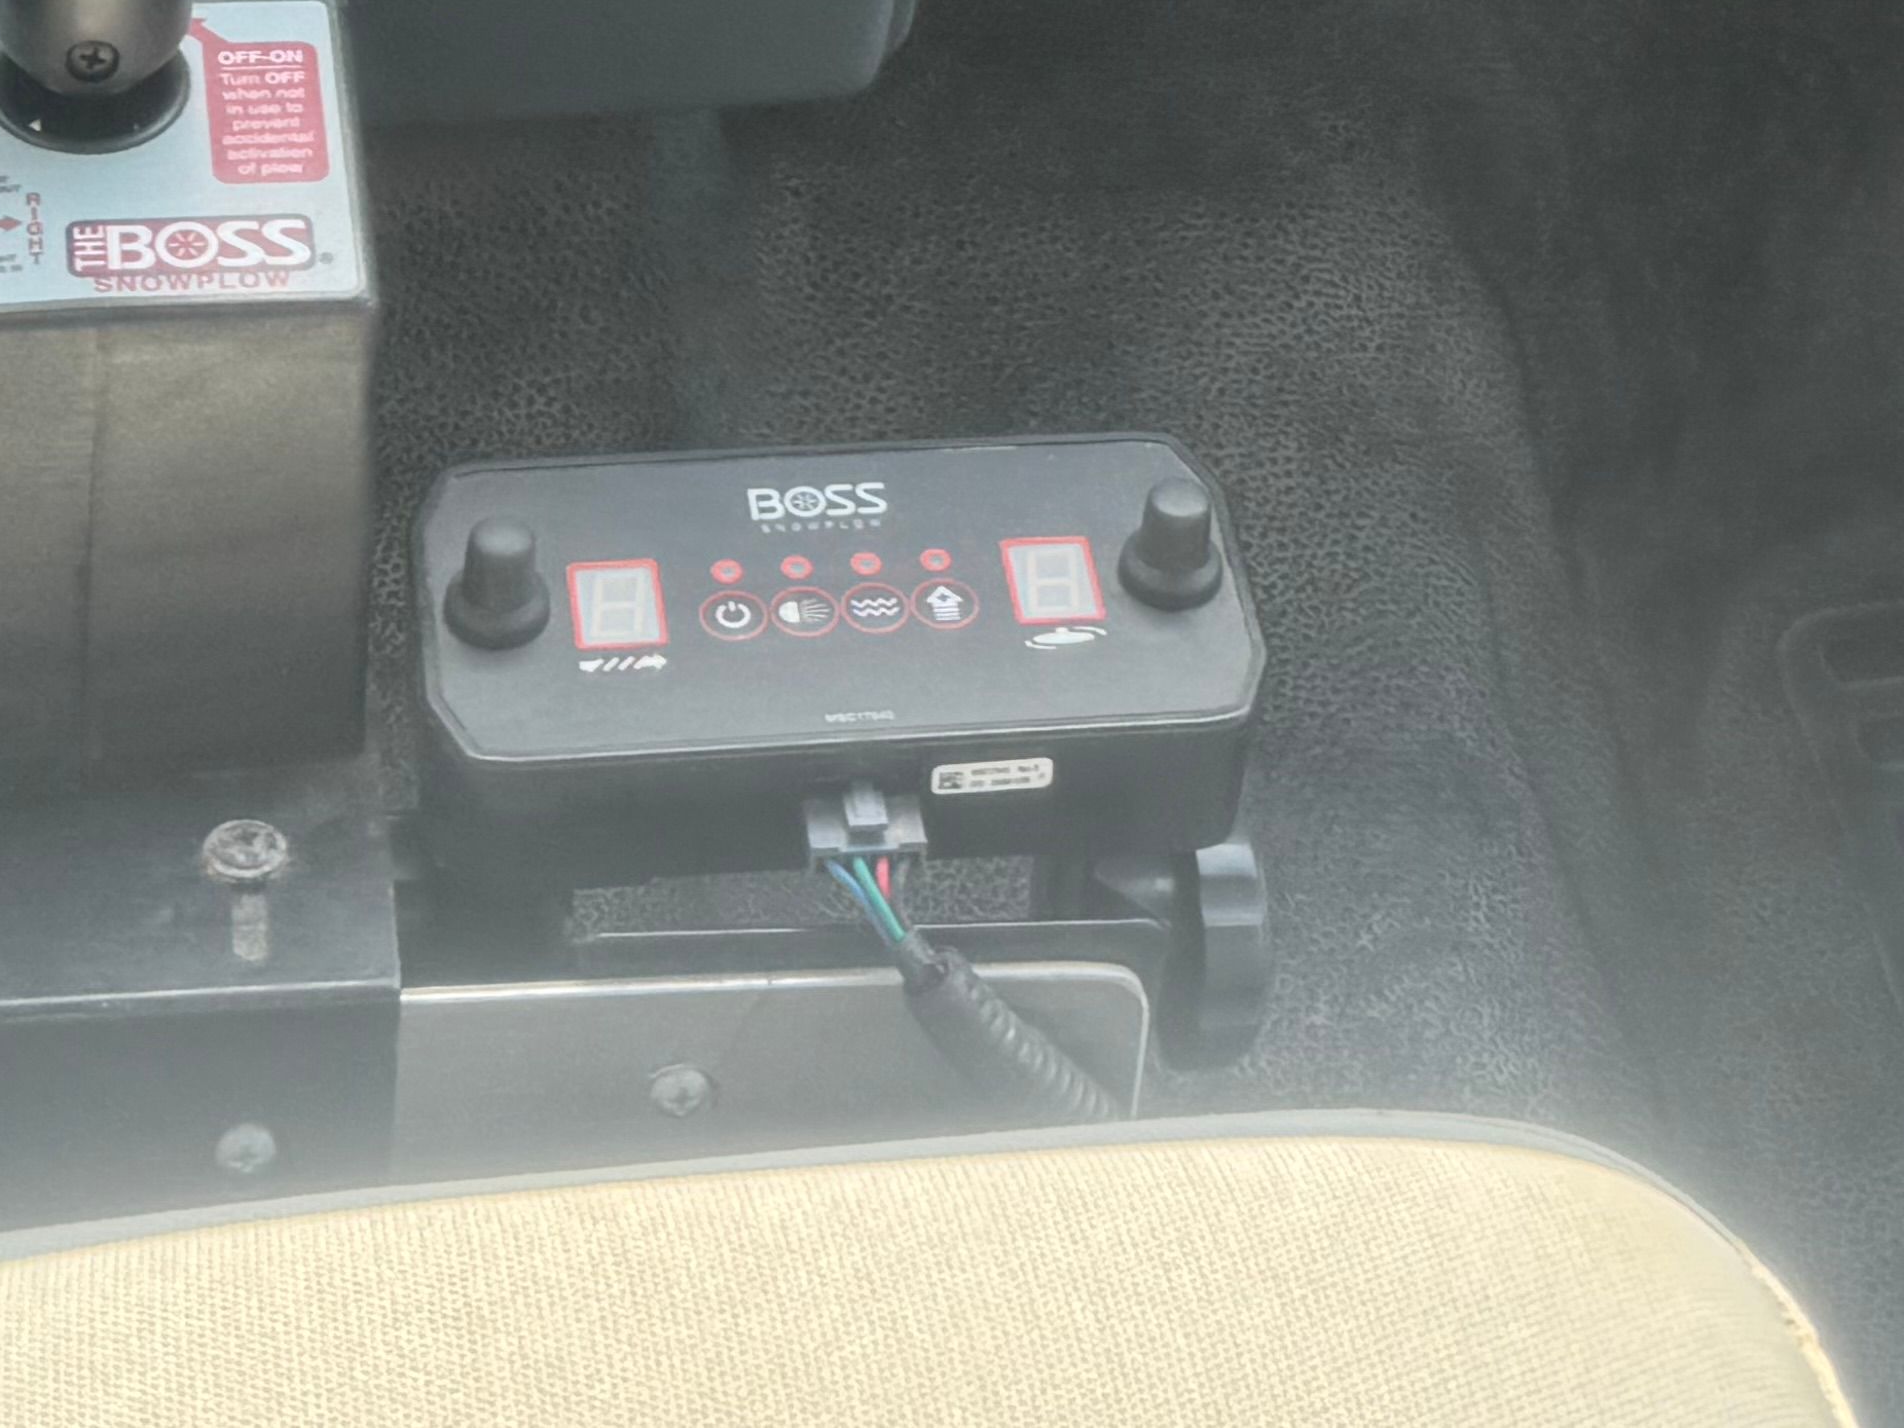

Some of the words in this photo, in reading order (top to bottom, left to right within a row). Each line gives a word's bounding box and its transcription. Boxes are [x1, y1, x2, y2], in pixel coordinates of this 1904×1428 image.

[219, 73, 261, 85] Turn
[264, 70, 305, 84] OFF
[275, 87, 306, 99] not
[286, 102, 304, 113] to
[72, 224, 106, 272] THE
[106, 219, 312, 271] BOSS
[94, 270, 291, 293] SNOWPLOW
[747, 481, 889, 521] BOSS
